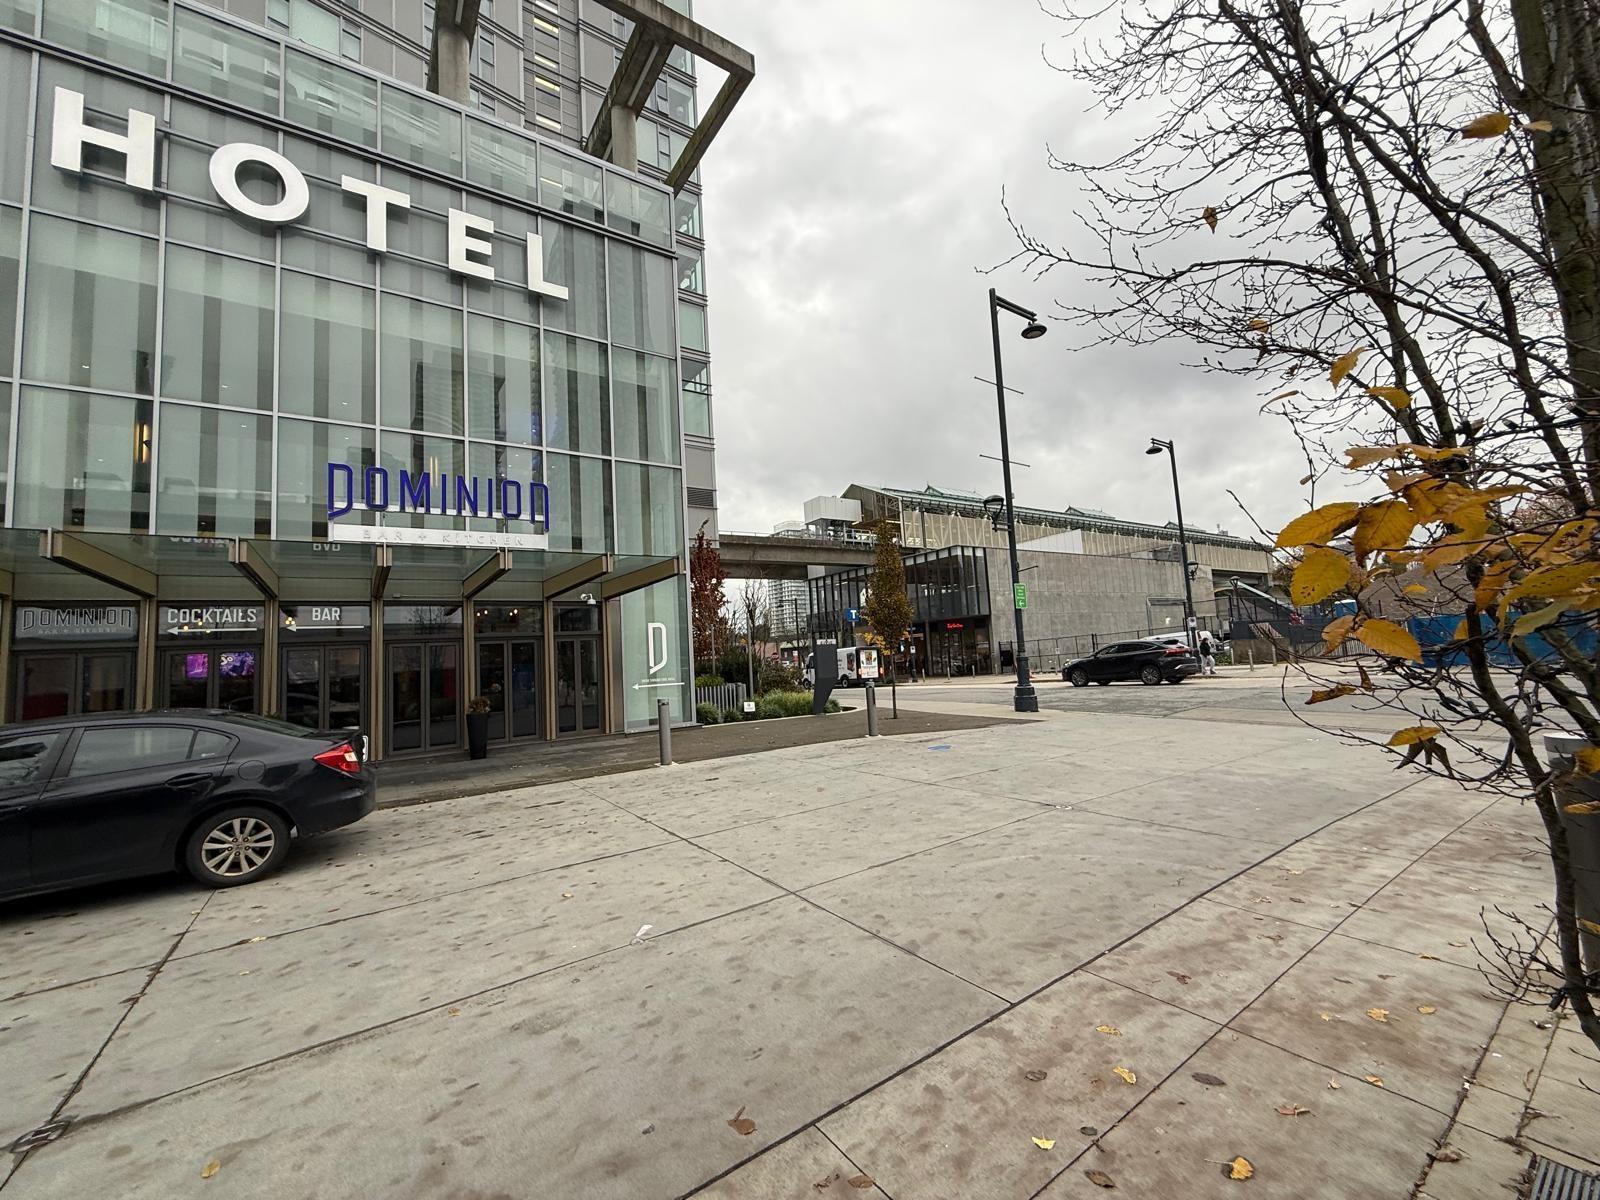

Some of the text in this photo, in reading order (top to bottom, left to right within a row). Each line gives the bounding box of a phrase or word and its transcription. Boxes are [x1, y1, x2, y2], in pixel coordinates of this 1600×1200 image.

[51, 86, 568, 300] HOTEL
[328, 463, 549, 532] DOMINION
[362, 529, 403, 541] BAR
[442, 534, 525, 546] KITCHEN
[23, 608, 132, 630] DOMINION
[167, 608, 257, 623] COCKTAILS
[312, 607, 341, 621] BAR
[850, 609, 857, 619] T
[647, 622, 668, 675] D
